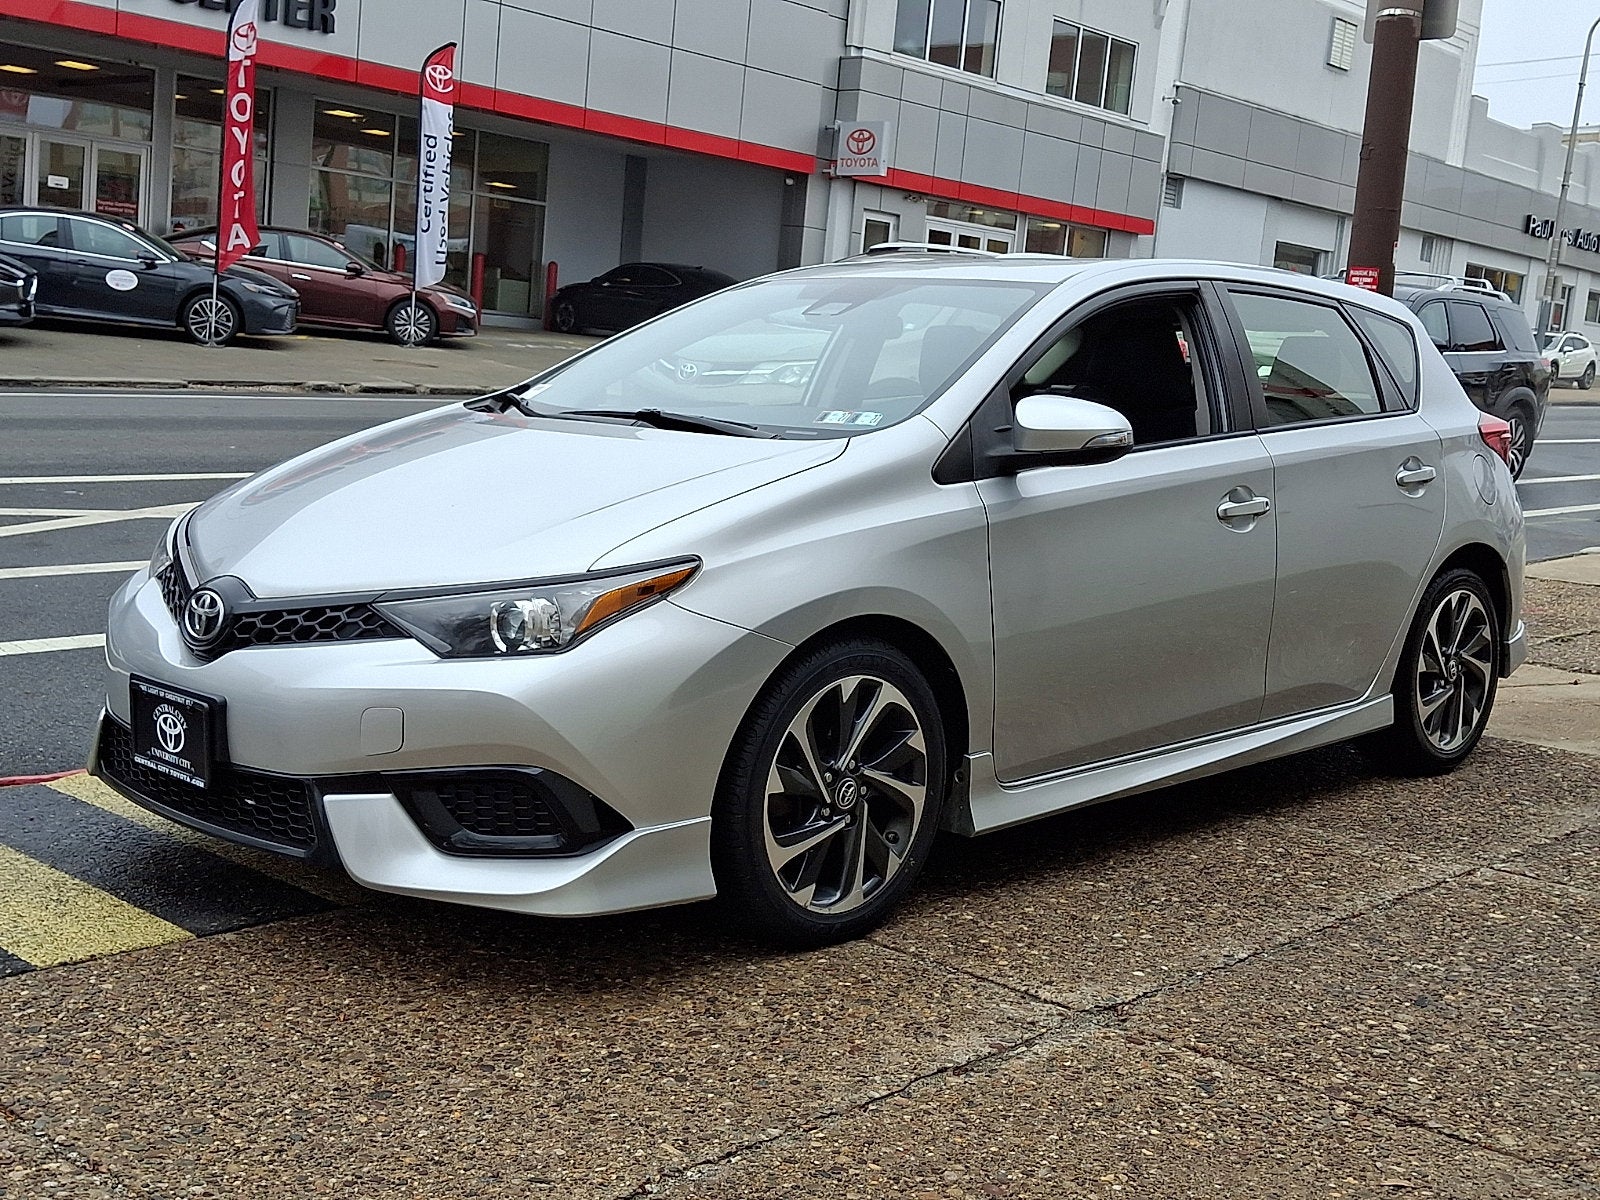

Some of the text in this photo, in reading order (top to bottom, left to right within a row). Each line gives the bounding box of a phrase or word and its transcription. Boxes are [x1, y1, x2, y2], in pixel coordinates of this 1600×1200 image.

[227, 58, 253, 252] TOYOTA
[839, 156, 879, 168] TOYOTA
[419, 133, 438, 234] Certified
[1526, 213, 1552, 240] Paul
[1576, 228, 1599, 252] Auto
[152, 703, 174, 721] CENTRAL
[134, 755, 157, 769] CENTRAL
[157, 764, 169, 774] CITY
[169, 769, 191, 784] TOYOTA
[151, 746, 191, 769] UNIVERSITY CITY
